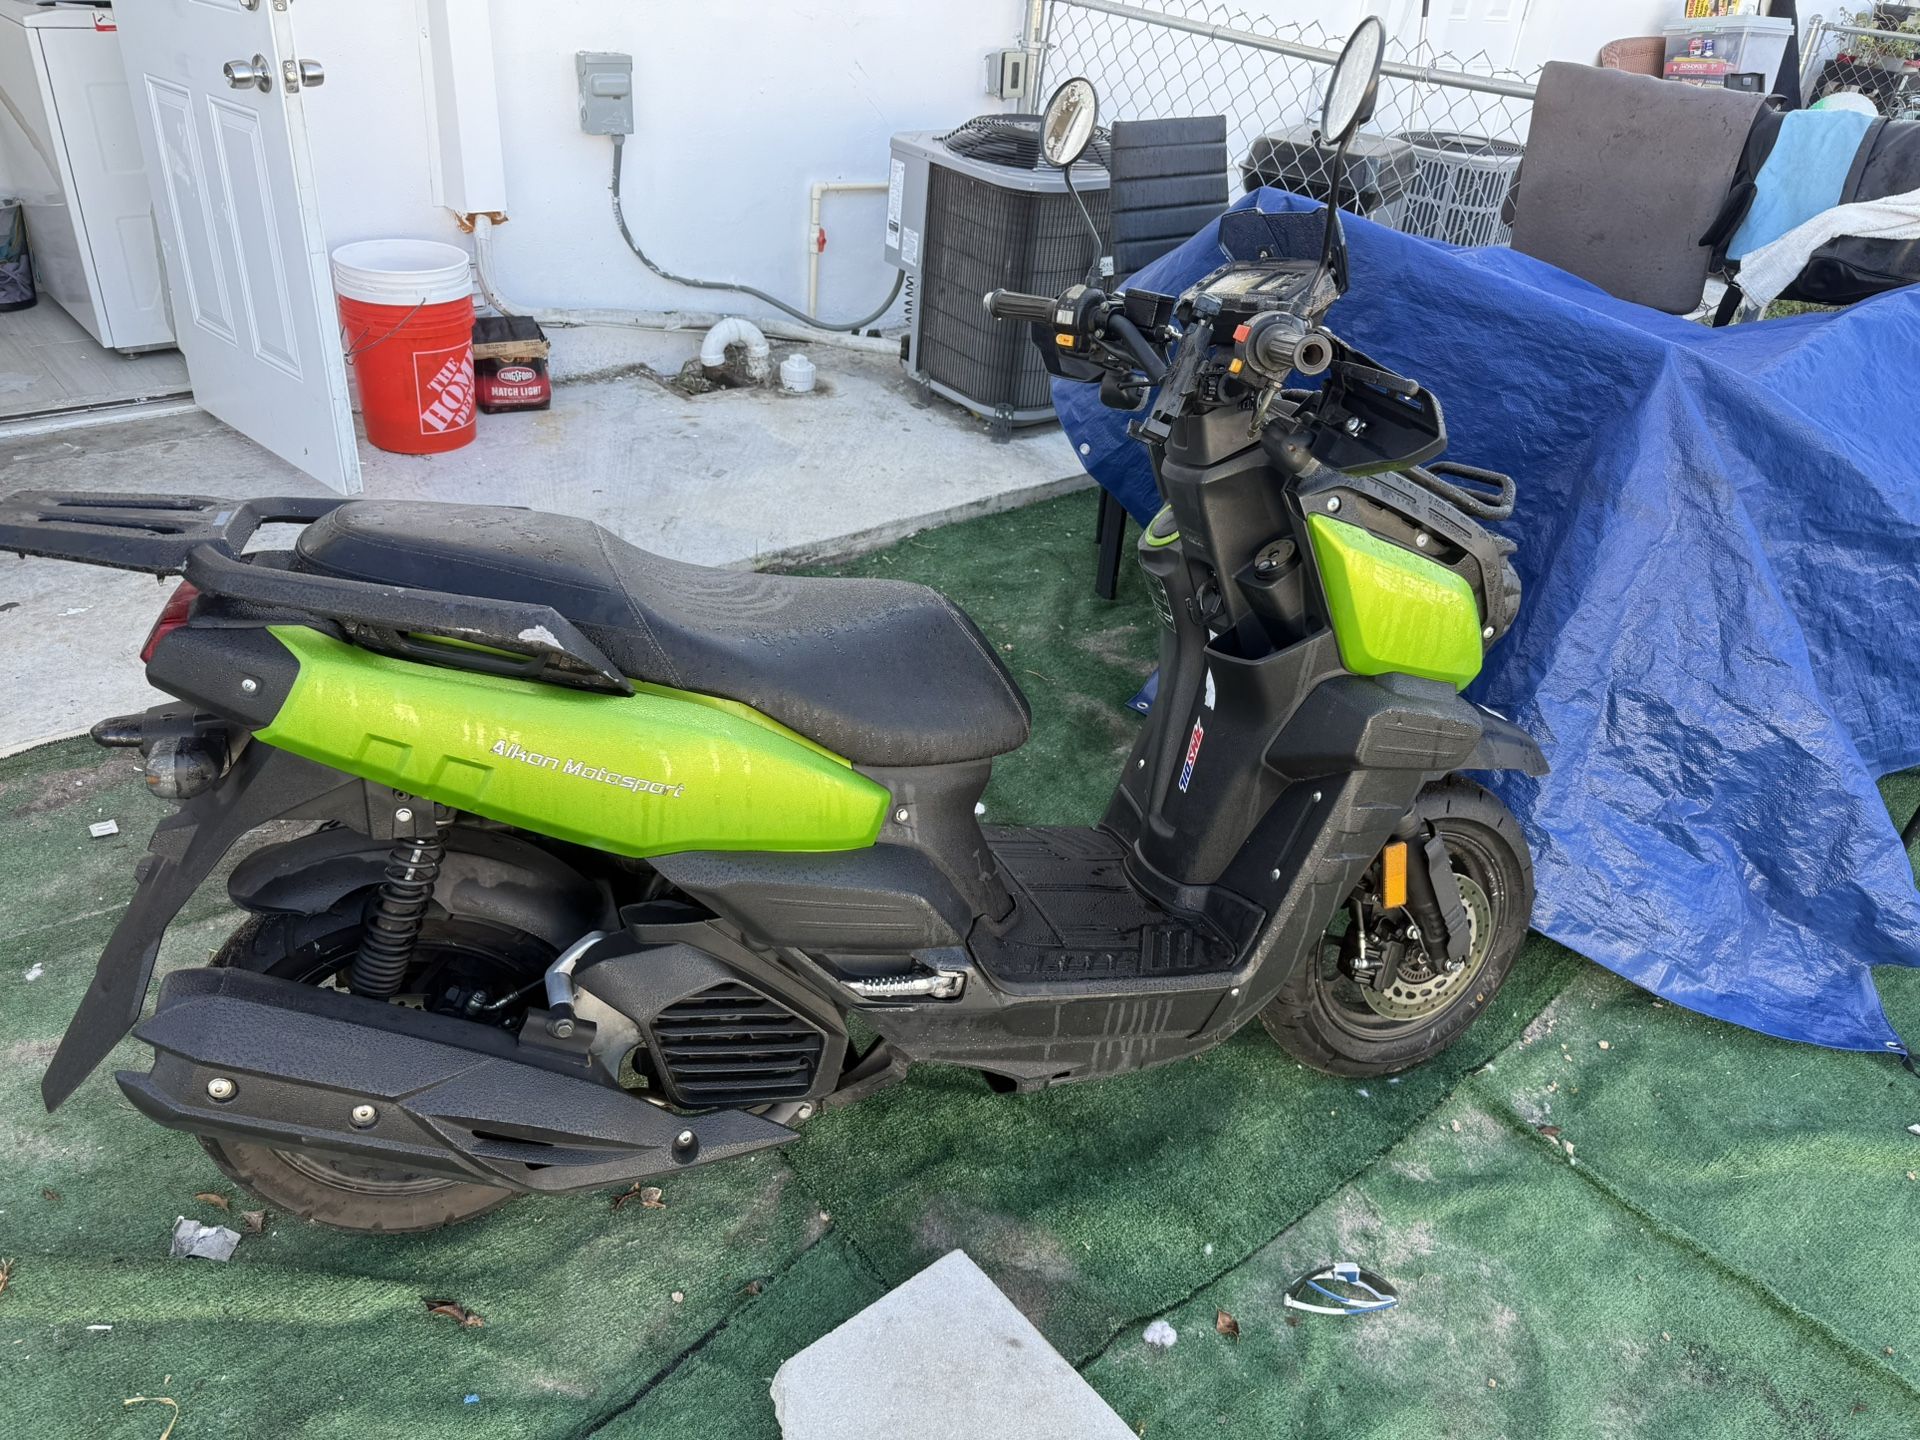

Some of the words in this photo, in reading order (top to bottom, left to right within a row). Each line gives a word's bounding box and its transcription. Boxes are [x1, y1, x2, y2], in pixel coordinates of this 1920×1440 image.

[427, 357, 459, 393] THE
[491, 386, 518, 396] MATCH
[520, 385, 541, 396] LIGHT
[500, 370, 533, 382] KINGSFORD
[490, 739, 560, 770] Alkon
[562, 758, 685, 799] Motosport
[1179, 717, 1204, 793] AMSOIL
